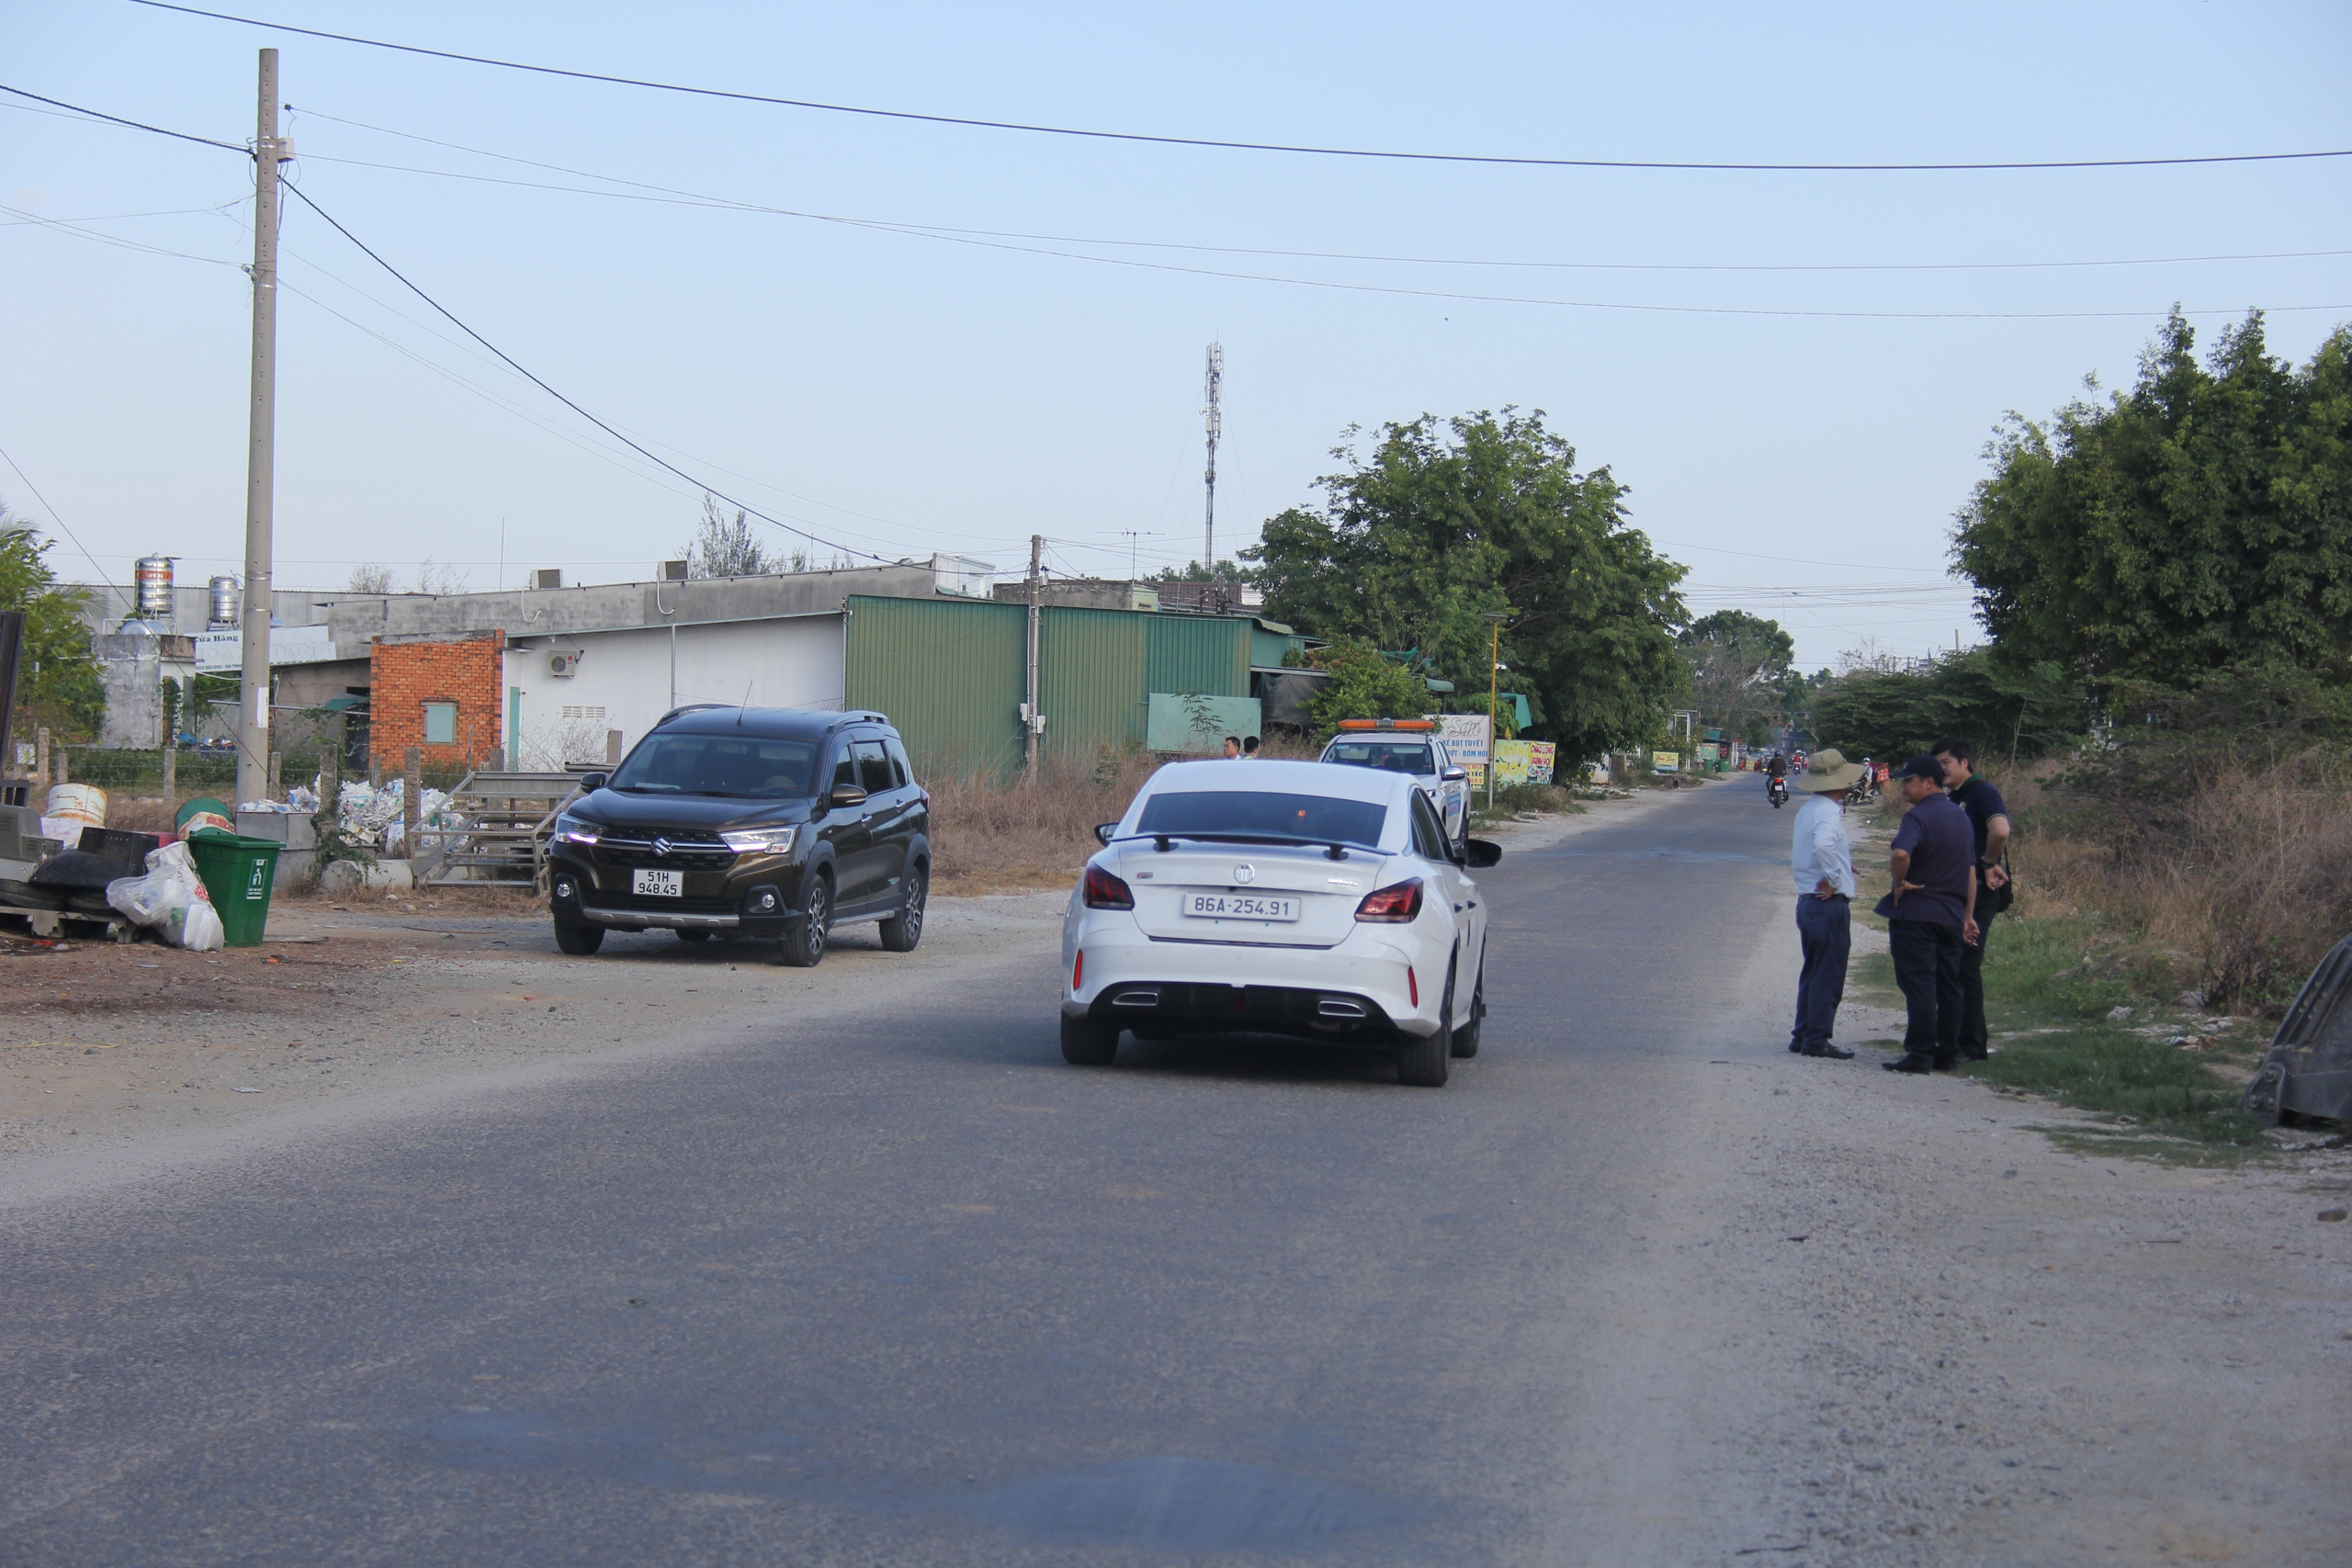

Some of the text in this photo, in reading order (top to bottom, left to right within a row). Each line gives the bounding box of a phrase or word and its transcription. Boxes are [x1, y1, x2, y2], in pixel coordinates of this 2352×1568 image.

[213, 634, 239, 642] Hàng
[1452, 739, 1464, 748] BỌT
[1464, 739, 1484, 747] TUYẾT
[1462, 749, 1476, 757] BƠM
[648, 871, 670, 883] 51H
[639, 882, 677, 896] 948.45
[1194, 897, 1289, 916] 86A-254.91
